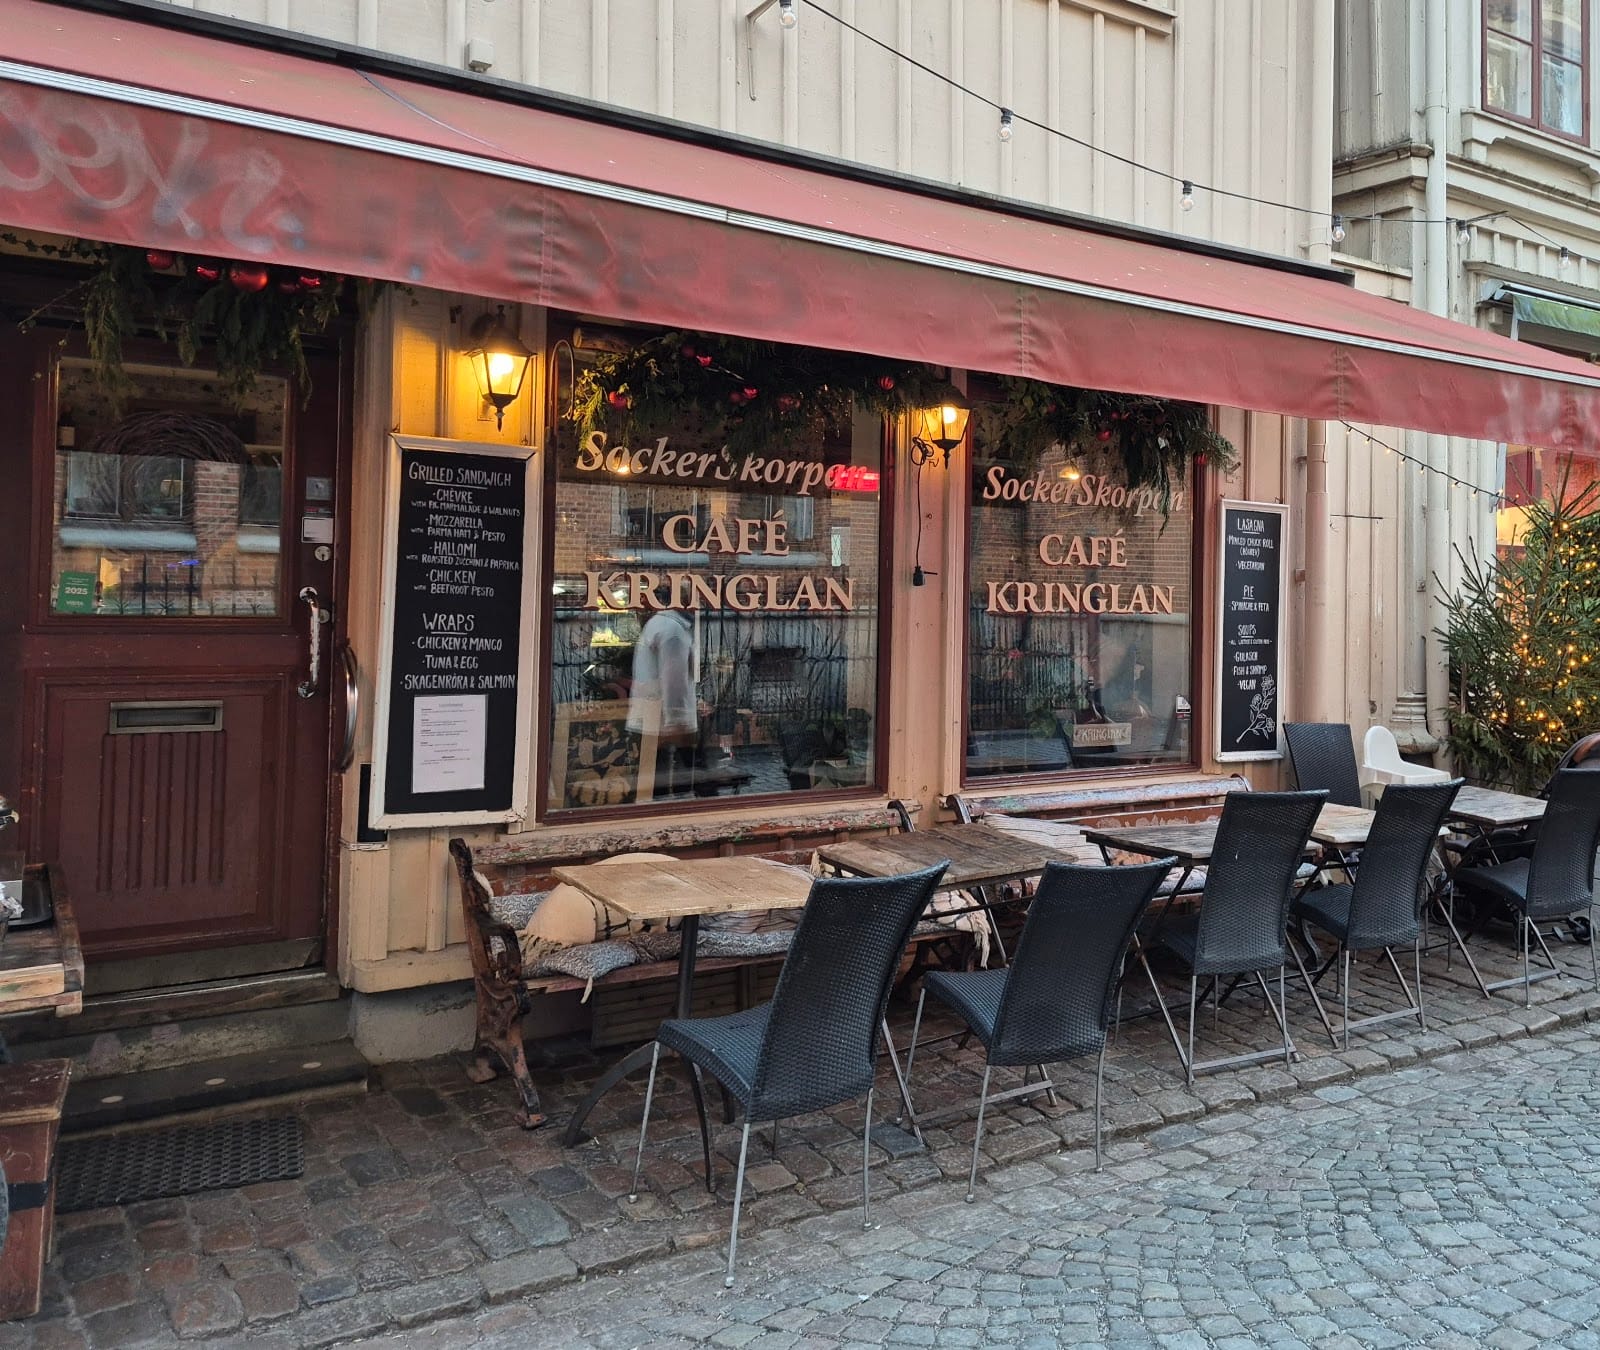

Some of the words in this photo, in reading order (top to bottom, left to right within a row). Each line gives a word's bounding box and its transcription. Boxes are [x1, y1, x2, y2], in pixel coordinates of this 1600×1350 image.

[408, 462, 453, 483] GRILLED
[457, 467, 512, 486] SANDWICH
[440, 502, 481, 514] MARMALADE
[489, 506, 520, 517] WALNUTS
[429, 514, 484, 529] MOZZARELLA
[428, 527, 452, 538] PARMA
[454, 528, 471, 539] HAM
[482, 530, 506, 542] PESTO
[663, 509, 789, 556] CAFÉ
[434, 541, 477, 559] HALLOMI
[1039, 528, 1128, 567] CAFÉ
[422, 554, 454, 565] ROASTED
[490, 559, 519, 570] PAPRIKA
[429, 569, 477, 584] CHICKEN
[64, 587, 89, 595] 2025
[431, 583, 470, 595] BEETROOT
[471, 585, 495, 597] PESTO
[583, 571, 857, 611] KRINGLAN
[1243, 584, 1255, 598] PIE
[986, 582, 1175, 614] KRINGLAN
[422, 612, 475, 631] WRAPS
[417, 636, 461, 650] CHICKEN
[469, 637, 503, 651] MANGO
[425, 654, 452, 669] TUNA
[460, 656, 479, 669] EGG
[478, 674, 516, 689] SALMON
[1239, 679, 1257, 690] VEGAN
